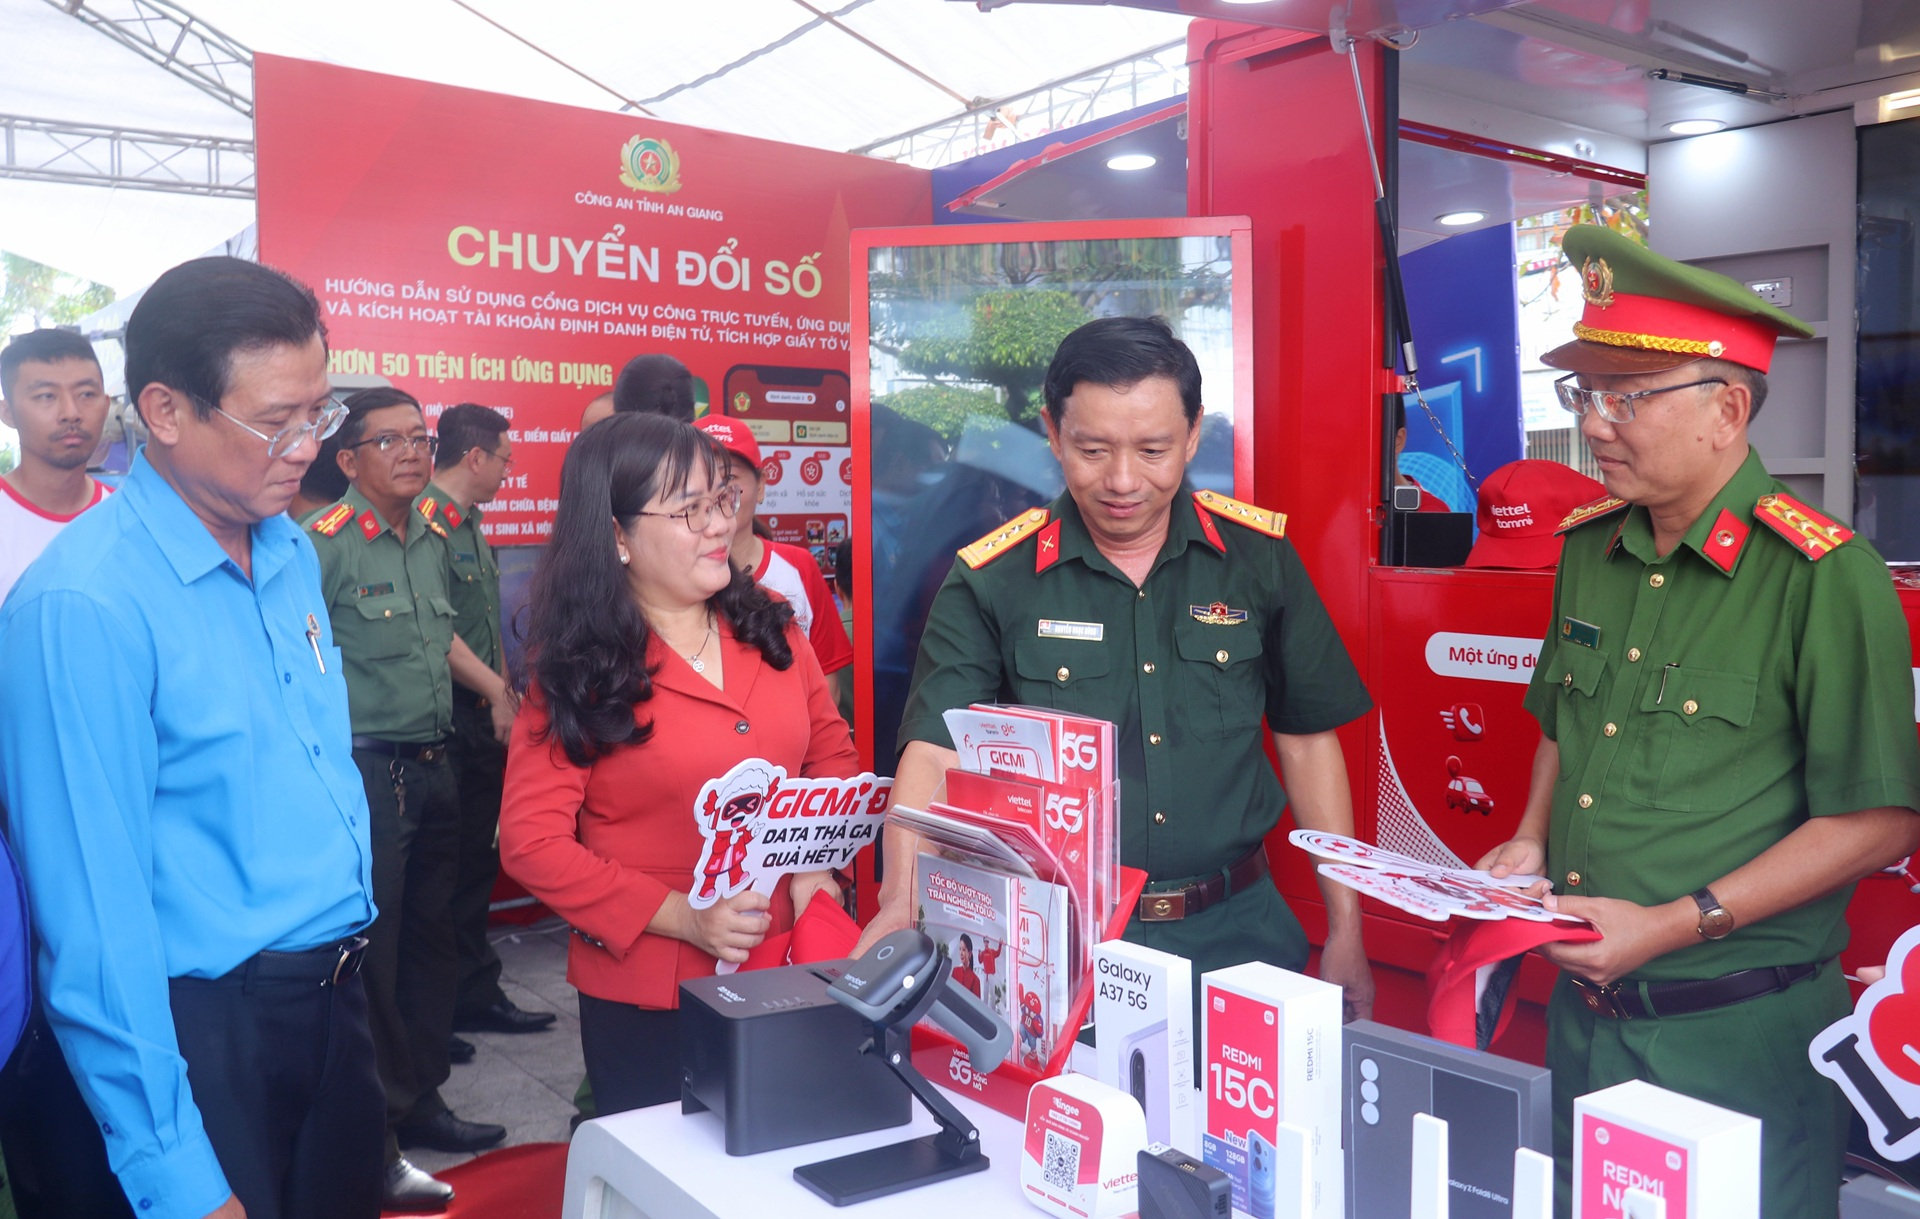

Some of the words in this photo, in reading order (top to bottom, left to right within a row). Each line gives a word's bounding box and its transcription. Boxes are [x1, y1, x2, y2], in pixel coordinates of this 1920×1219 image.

[575, 191, 612, 207] CÔNG
[616, 198, 633, 210] AN
[636, 199, 664, 214] TỈNH
[667, 204, 684, 217] AN
[687, 207, 723, 222] GIANG
[448, 223, 659, 283] CHUYỂN
[676, 237, 750, 292] ĐỔI
[764, 252, 822, 298] SỐ
[325, 278, 394, 298] HƯỚNG
[402, 280, 440, 301] DẪN
[446, 284, 471, 304] SỬ
[476, 290, 525, 309] DỤNG
[531, 291, 579, 313] CỔNG
[585, 299, 622, 317] DỊCH
[628, 304, 648, 320] VỤ
[653, 303, 696, 321] CÔNG
[701, 310, 740, 326] TRỰC
[744, 312, 792, 330] TUYẾN,
[797, 315, 825, 333] ỨNG
[325, 300, 352, 316] VÀ
[358, 301, 402, 320] KÍCH
[409, 306, 458, 325] HOẠT
[466, 309, 490, 327] TÀI
[496, 311, 555, 331] KHOẢN
[560, 318, 599, 335] ĐỊNH
[604, 322, 647, 337] DANH
[652, 324, 687, 342] ĐIỆN
[691, 325, 713, 344] TỬ,
[717, 328, 749, 344] TÍCH
[753, 332, 781, 349] HỢP
[785, 332, 816, 350] GIẤY
[840, 339, 850, 351] V
[328, 349, 375, 375] HƠN
[382, 353, 409, 377] 50
[416, 351, 463, 383] TIỆN
[470, 353, 505, 382] ÍCH
[512, 356, 553, 384] ỨNG
[559, 363, 613, 389] DỤNG
[516, 473, 528, 489] TẾ
[510, 497, 535, 512] CHỮA
[537, 498, 559, 515] BỆN
[1491, 503, 1532, 517] iettel
[495, 523, 519, 536] SINH
[521, 521, 535, 535] XÃ
[1449, 646, 1483, 666] Một
[1487, 648, 1518, 670] ứng
[1062, 732, 1098, 770] 5G
[1007, 795, 1033, 808] viettel
[1045, 793, 1083, 834] 5G
[762, 827, 808, 844] DATA
[814, 820, 848, 841] THẢ
[849, 824, 872, 839] GA
[802, 840, 839, 865] HẾT
[841, 842, 854, 862] Ý
[929, 871, 945, 888] TỐC
[946, 879, 957, 893] ĐỘ
[957, 884, 976, 899] VƯỢT
[946, 894, 974, 912] NGHIỆM
[974, 902, 986, 917] TỐI
[1098, 957, 1151, 991] Galaxy
[1100, 982, 1123, 1002] A37
[1128, 990, 1147, 1010] 5G
[953, 1049, 969, 1060] viette
[1222, 1043, 1262, 1072] REDMI
[949, 1056, 972, 1085] 5G
[1210, 1062, 1275, 1119] 15C
[1822, 1033, 1920, 1147] I
[1203, 1140, 1217, 1152] 8GB
[1225, 1149, 1246, 1164] 128GB
[1225, 1130, 1247, 1149] New
[1103, 1172, 1138, 1190] viette
[1602, 1159, 1664, 1198] REDMI
